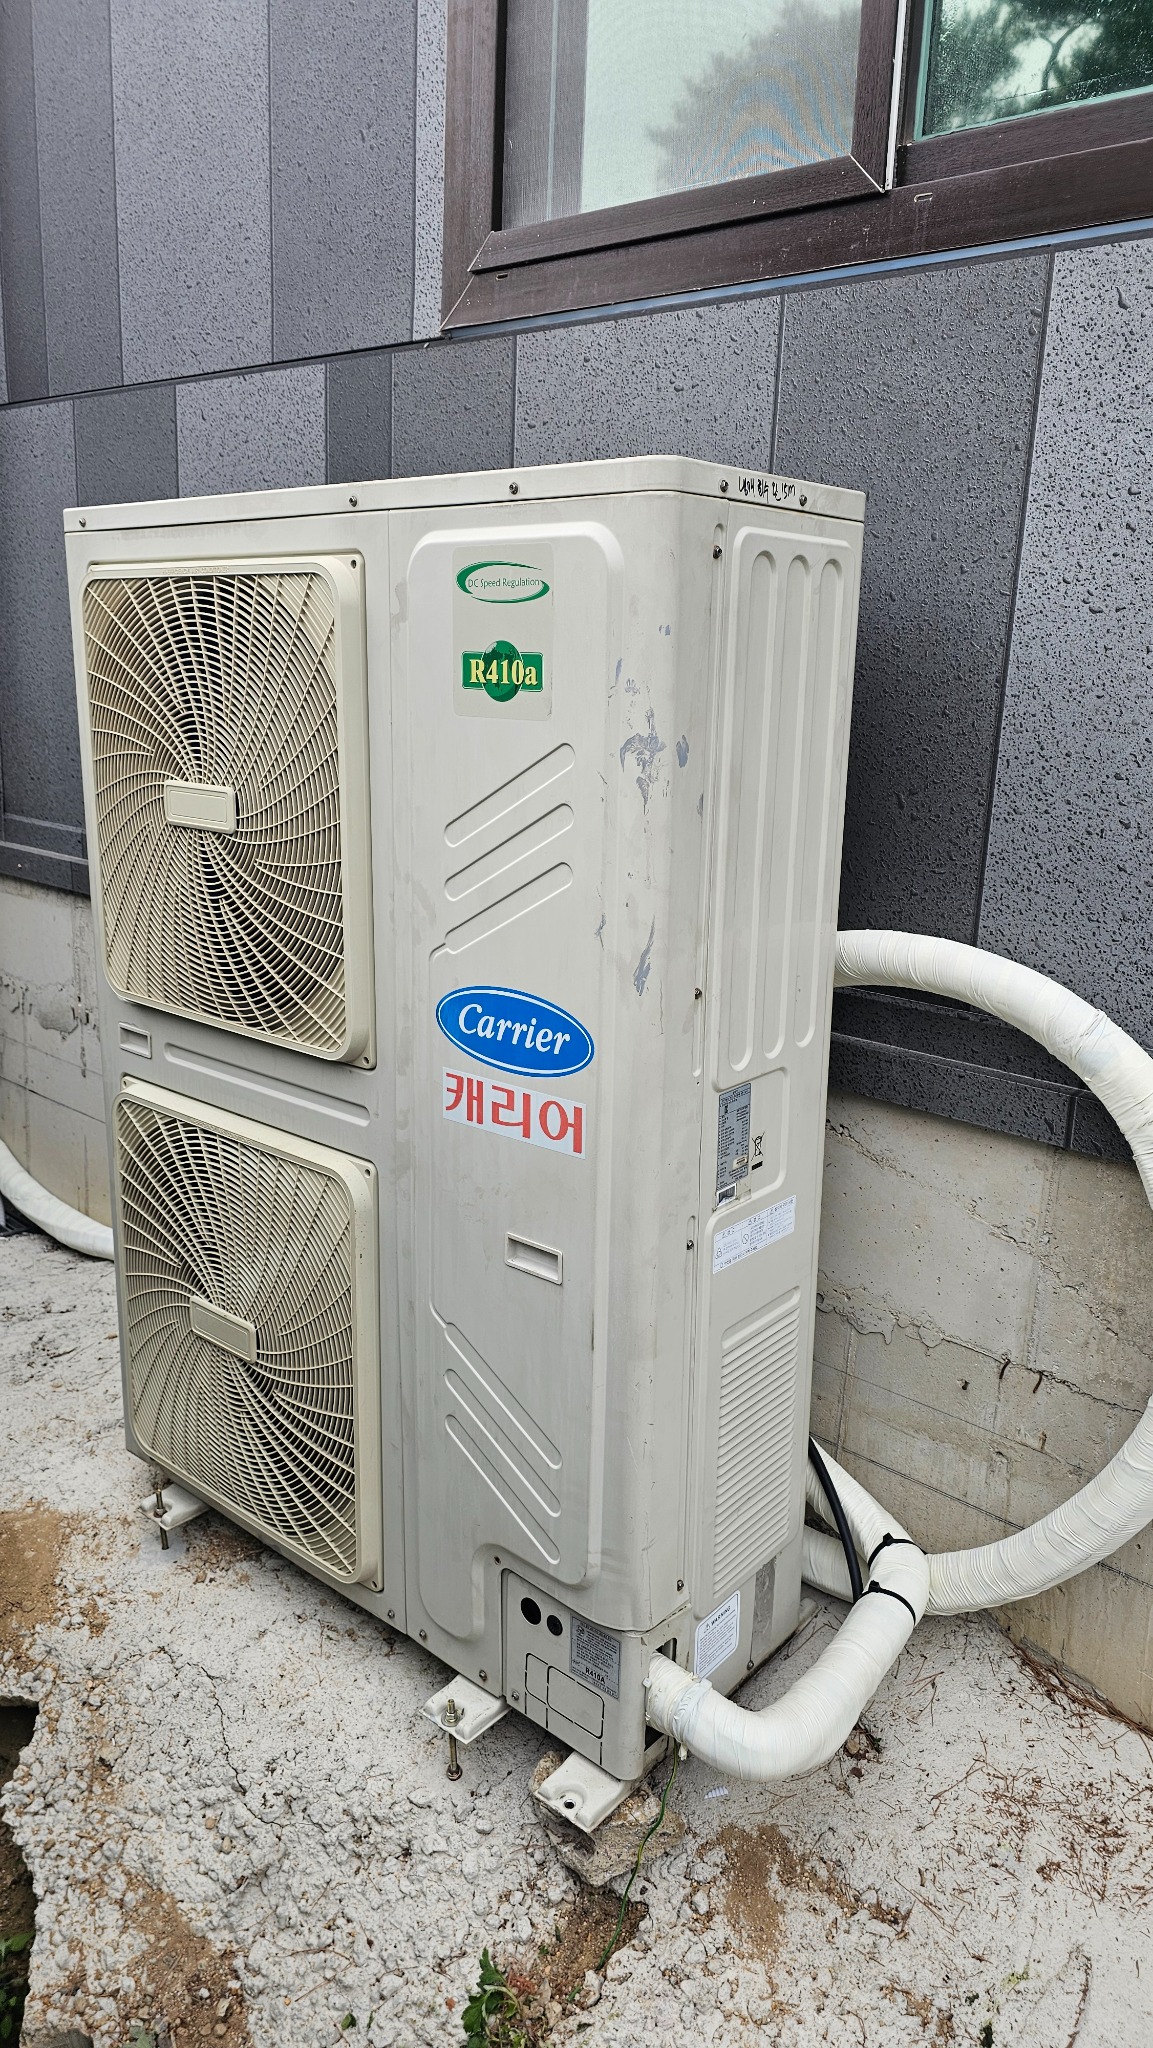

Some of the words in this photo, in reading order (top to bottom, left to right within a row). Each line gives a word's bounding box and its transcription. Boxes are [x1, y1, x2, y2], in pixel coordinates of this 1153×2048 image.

[468, 579, 479, 588] DC
[480, 578, 501, 589] Speed
[502, 577, 540, 588] Regulation
[469, 658, 538, 686] R410a
[458, 1003, 571, 1055] Carrier
[445, 1072, 583, 1154] 캐리어
[711, 1605, 731, 1626] WARNING
[585, 1667, 605, 1684] R410A
